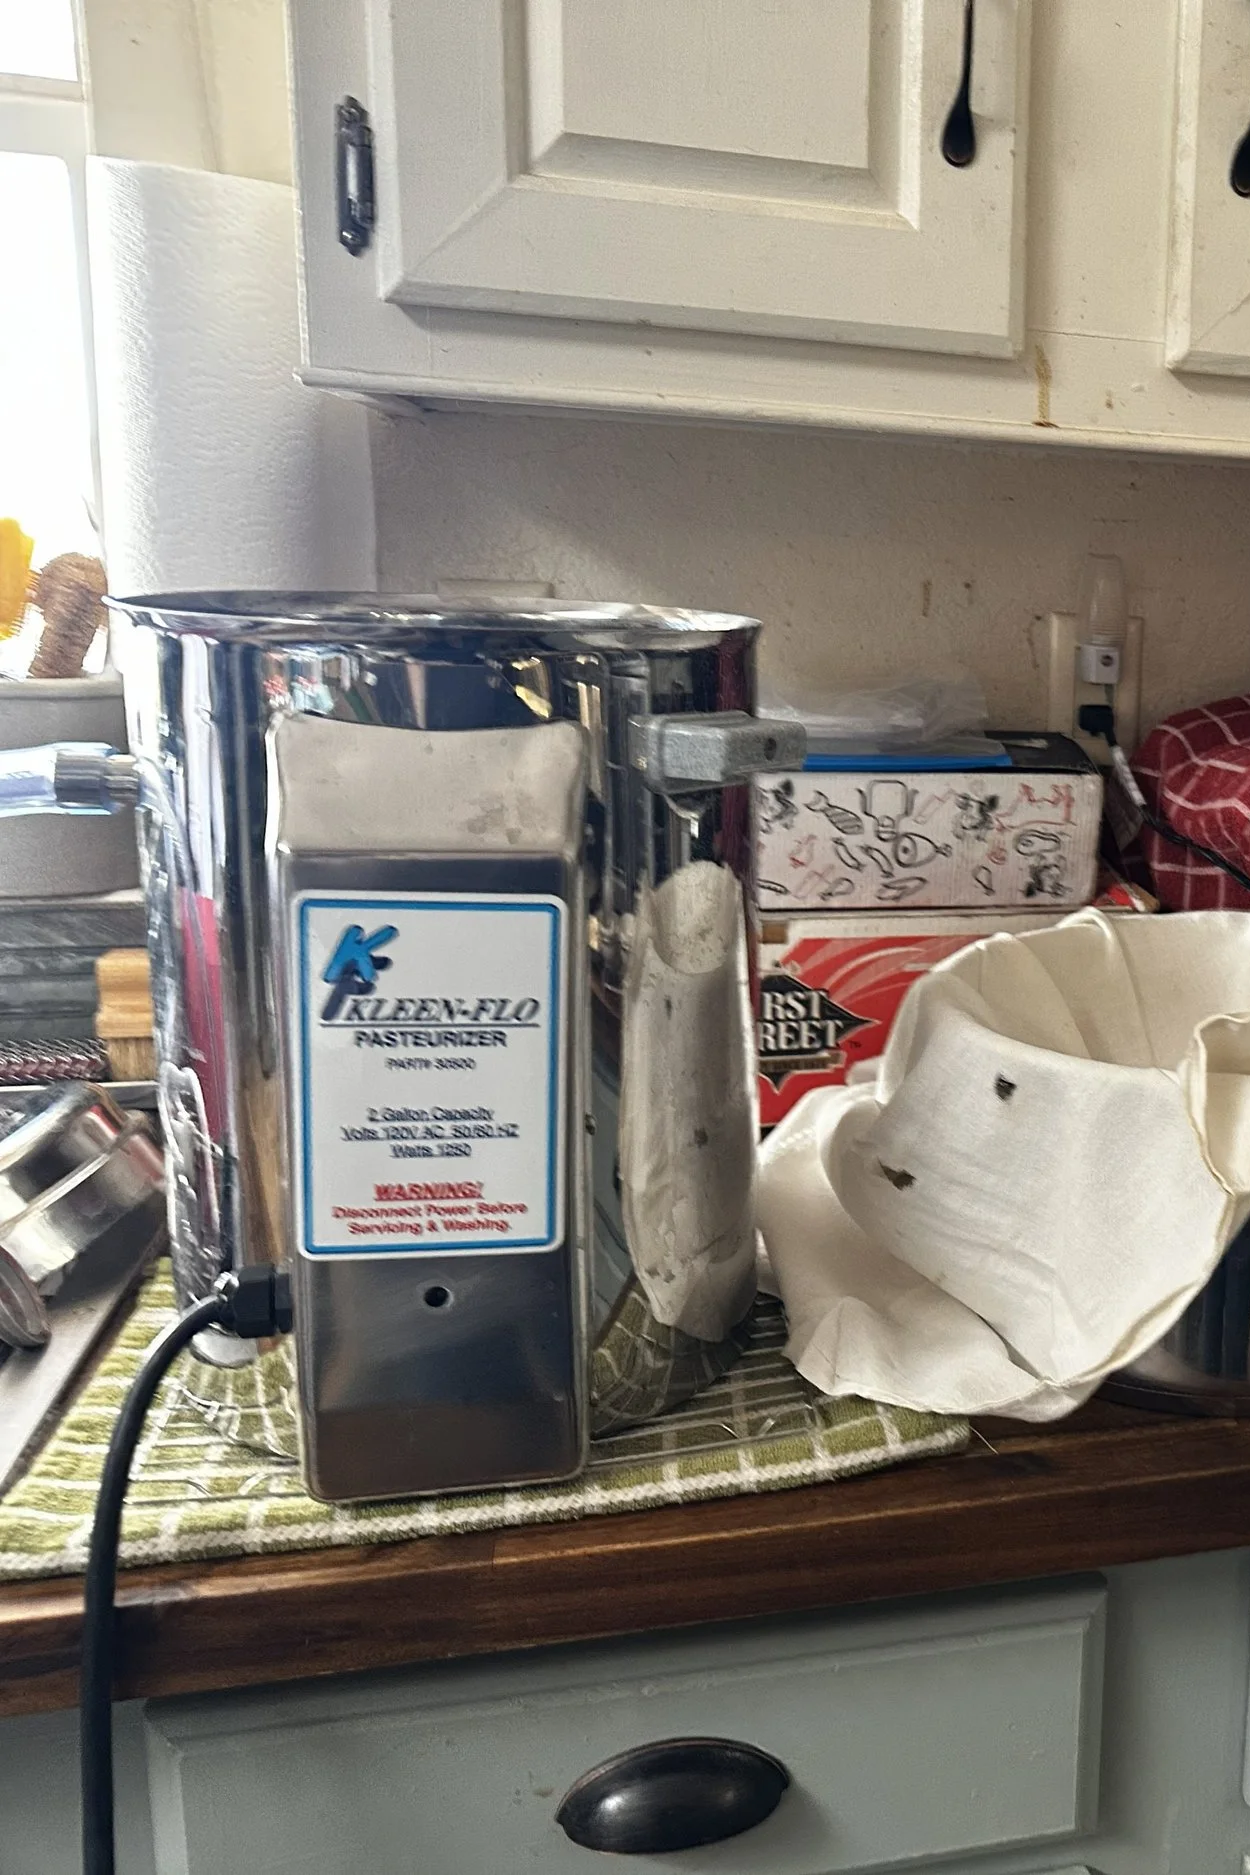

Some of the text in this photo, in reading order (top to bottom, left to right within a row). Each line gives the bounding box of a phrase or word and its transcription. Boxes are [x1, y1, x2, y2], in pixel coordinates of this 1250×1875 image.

[344, 997, 541, 1022] KLEEN-FLO
[762, 990, 829, 1020] RST
[353, 1030, 508, 1048] PASTEURIZER
[758, 1020, 844, 1052] REET
[380, 1106, 430, 1122] Gallon
[431, 1105, 494, 1121] Capacity
[339, 1125, 379, 1141] Volts
[421, 1124, 445, 1139] AC
[389, 1143, 434, 1158] Watts
[373, 1181, 485, 1201] WARNING!
[331, 1202, 529, 1219] Disconnect Power Before
[347, 1221, 424, 1236] Servicing
[426, 1219, 439, 1233] &
